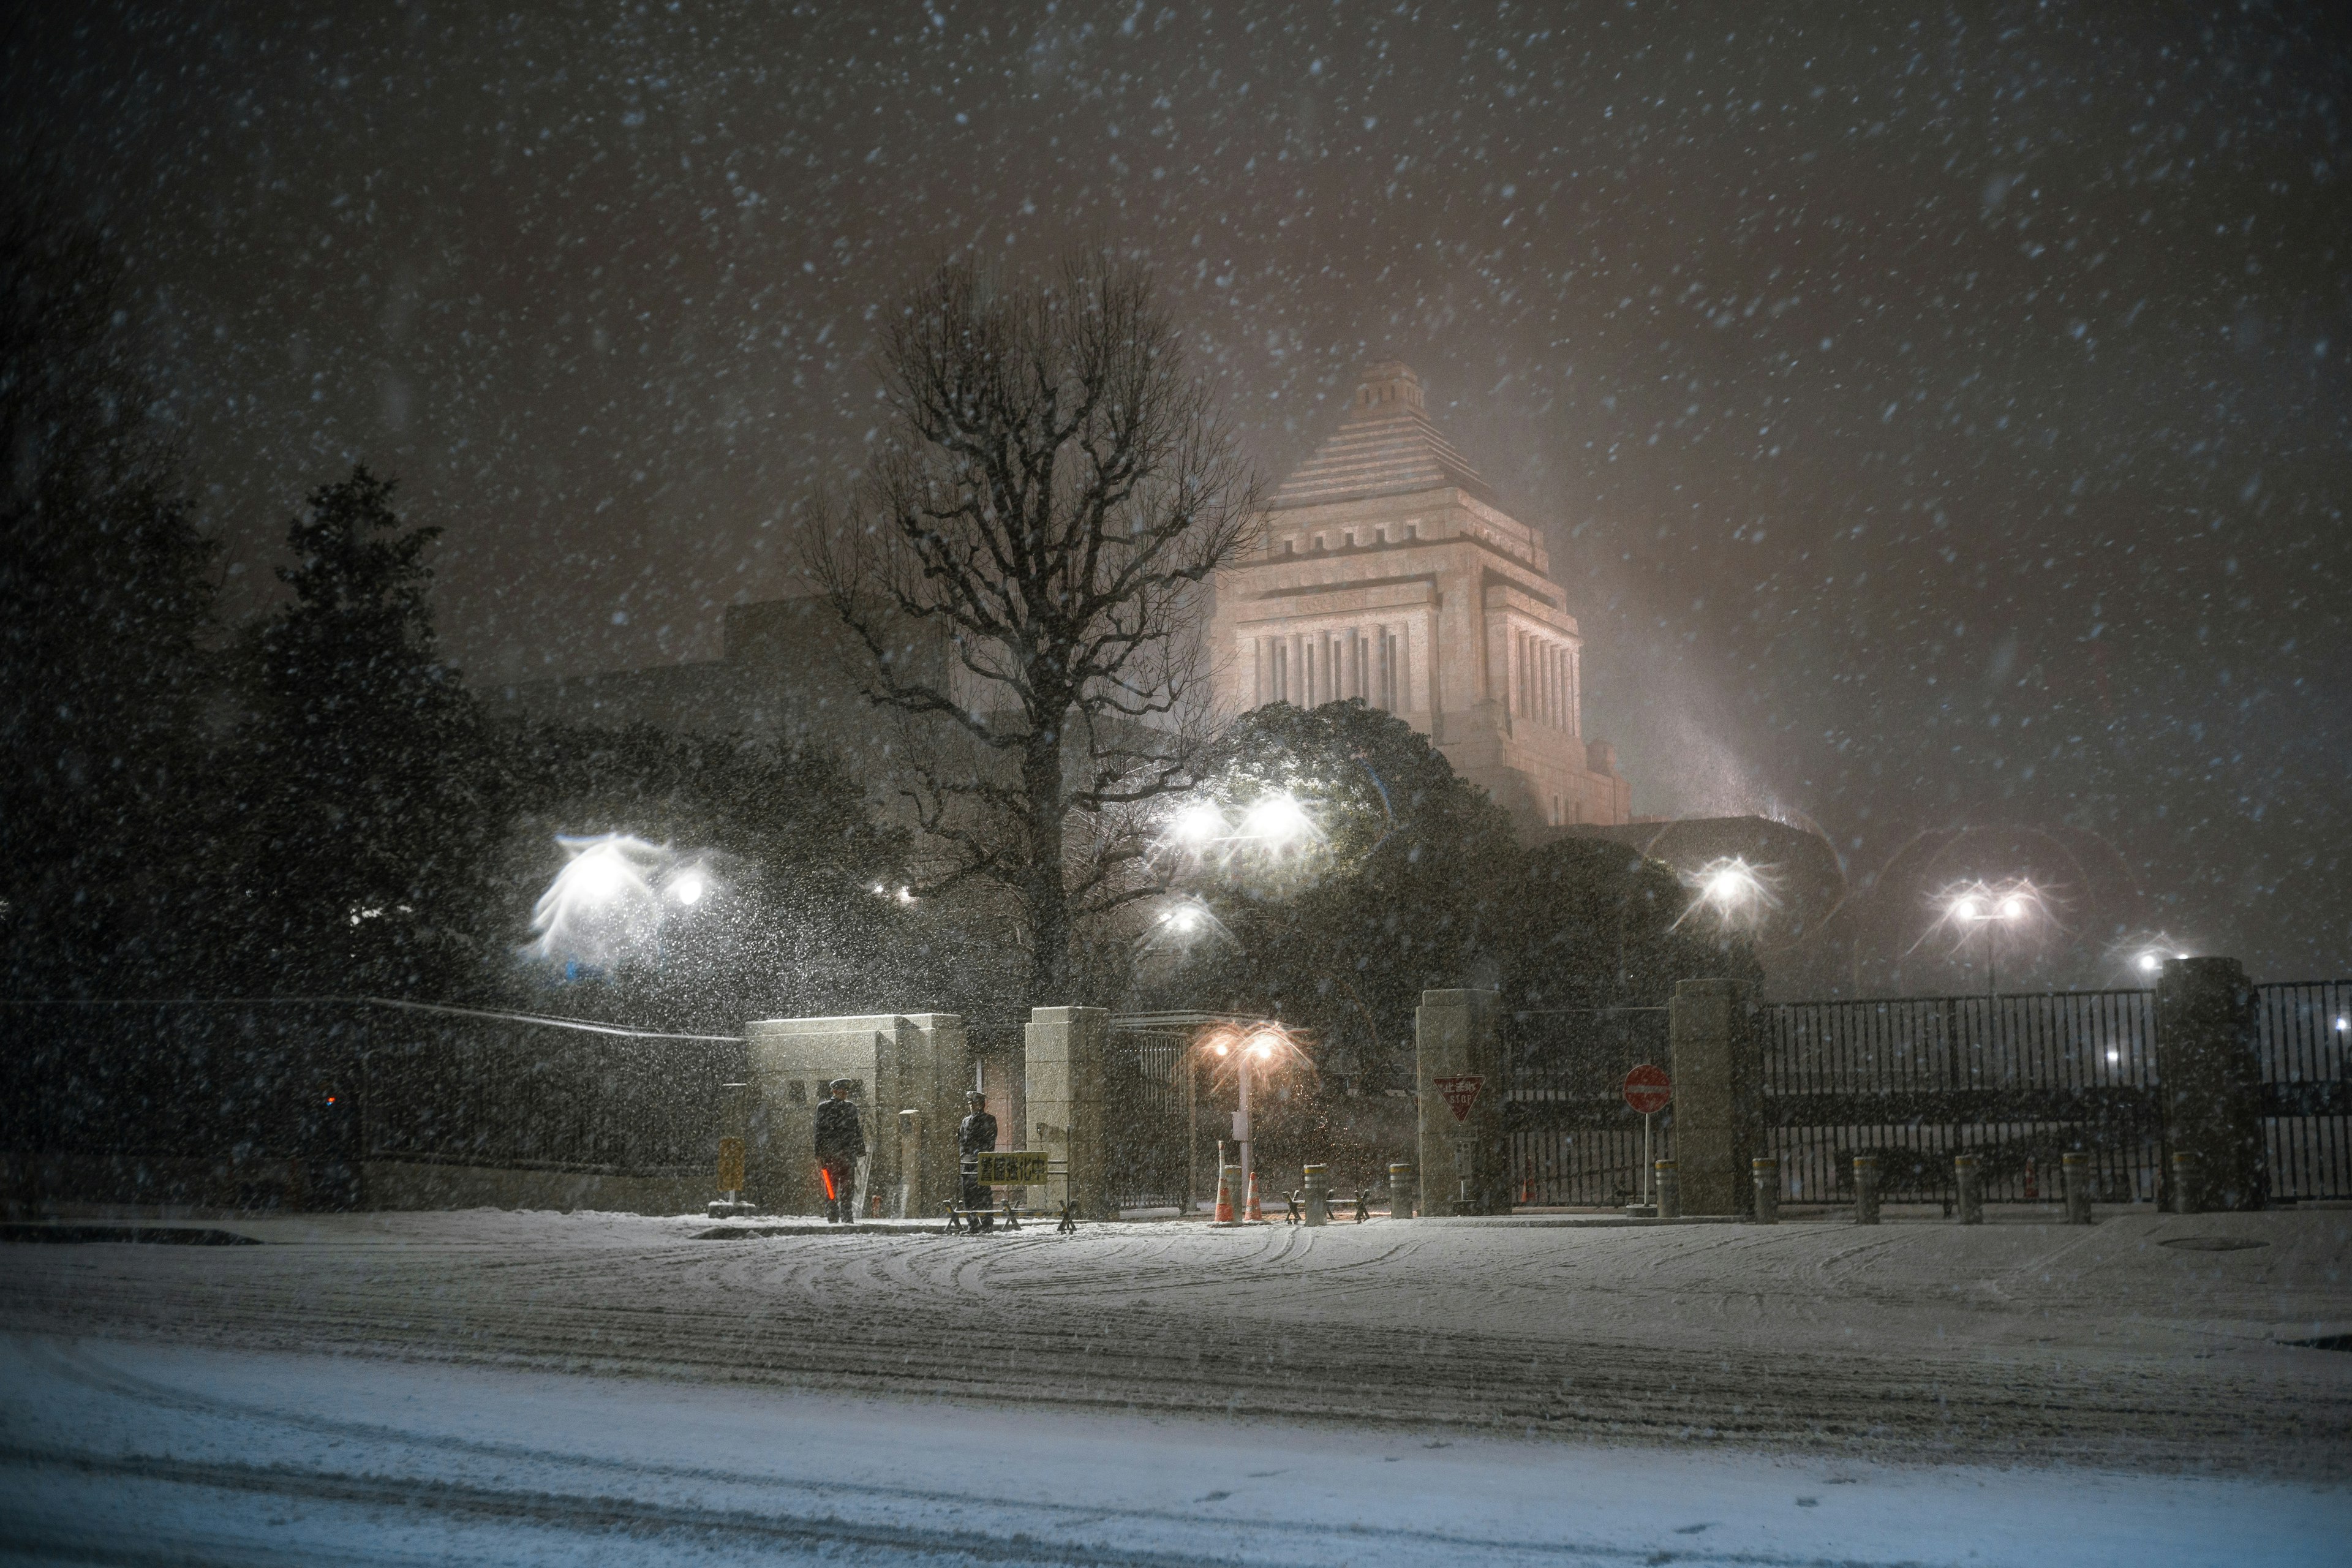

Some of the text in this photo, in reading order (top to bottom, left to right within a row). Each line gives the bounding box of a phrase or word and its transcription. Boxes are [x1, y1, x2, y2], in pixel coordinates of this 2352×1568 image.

[1444, 1082, 1476, 1092] 止まれ
[1450, 1095, 1471, 1104] STOP
[981, 1156, 1045, 1181] 警備強化中
